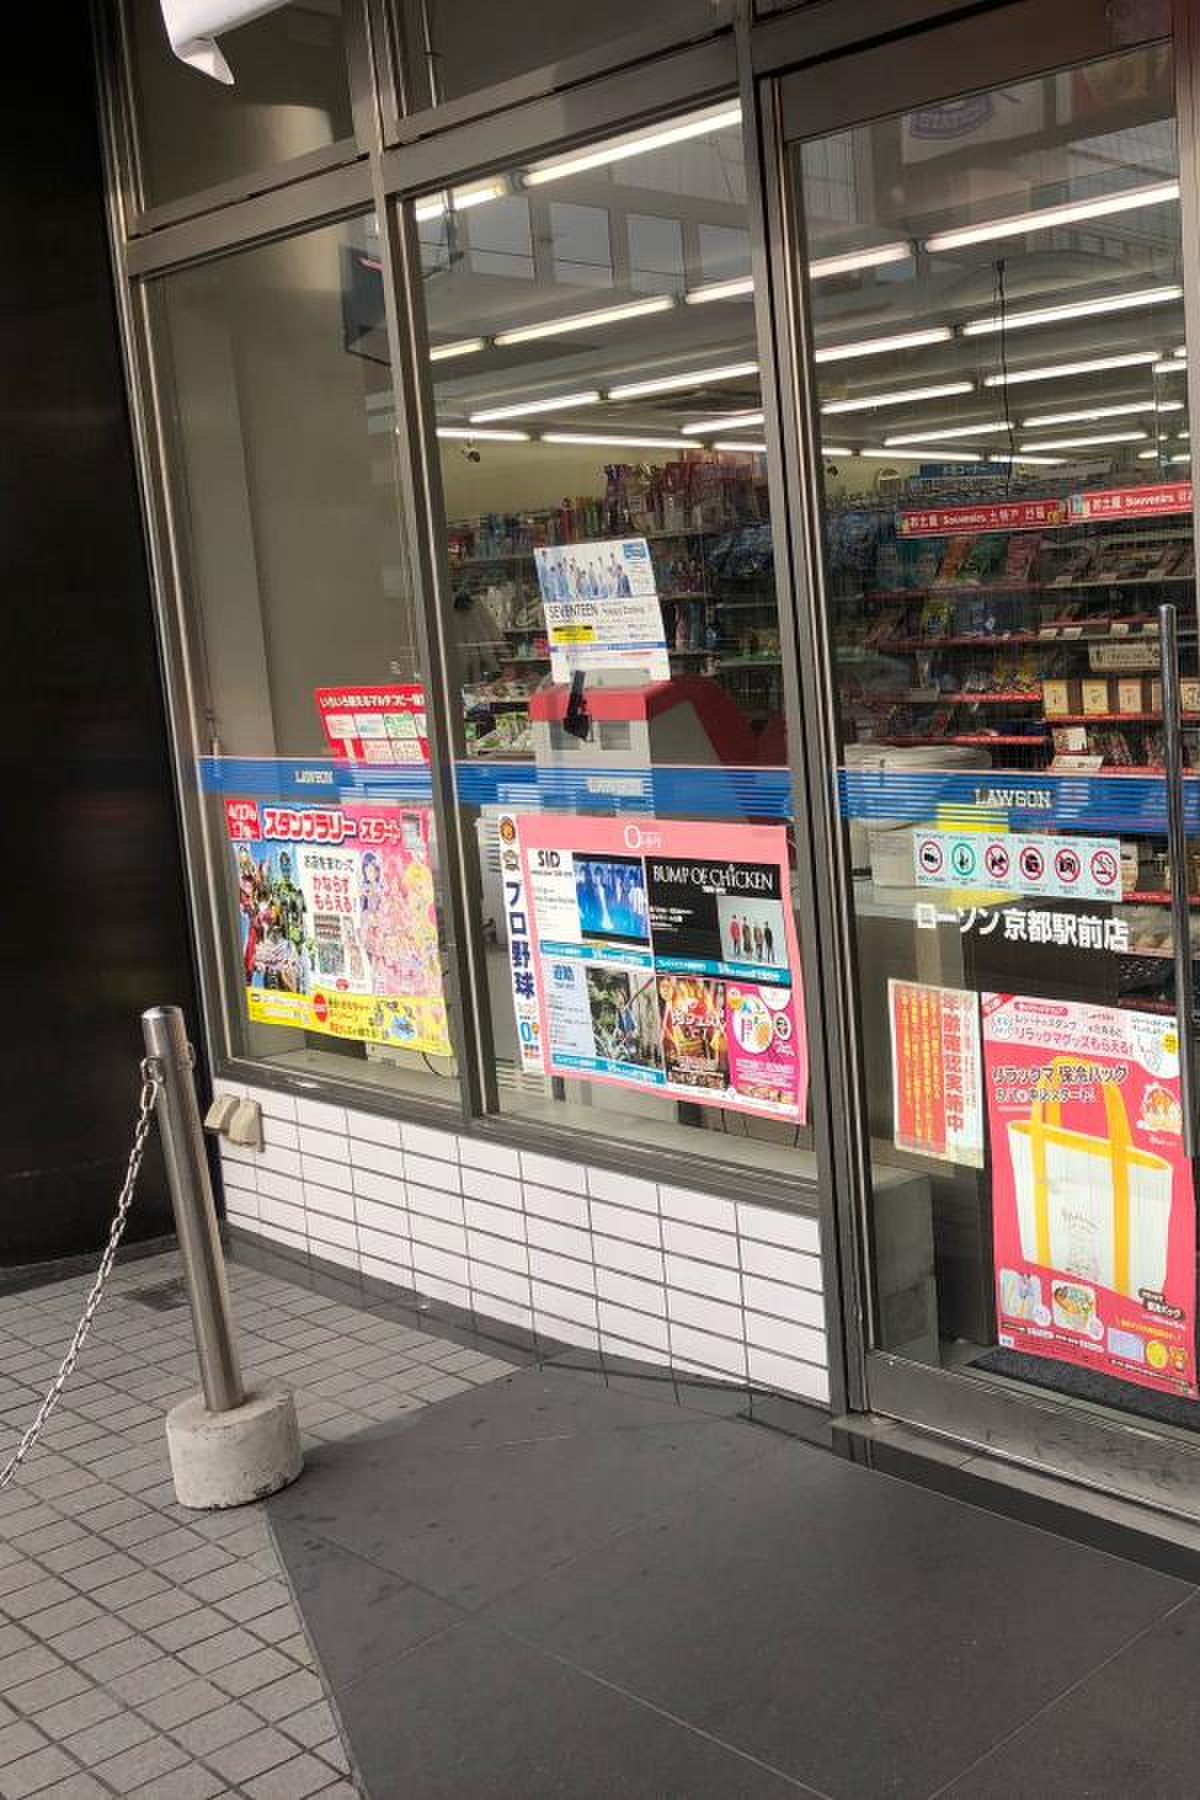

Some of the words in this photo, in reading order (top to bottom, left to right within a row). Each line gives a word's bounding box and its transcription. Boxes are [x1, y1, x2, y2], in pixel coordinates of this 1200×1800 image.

[975, 788, 1051, 808] LAWSON
[264, 808, 357, 842] スタンプラリー
[537, 850, 561, 868] SID
[652, 864, 691, 886] BUMP
[707, 863, 774, 891] CHICKEN
[915, 902, 998, 936] ローソン
[1003, 908, 1130, 952] 京都駅前店
